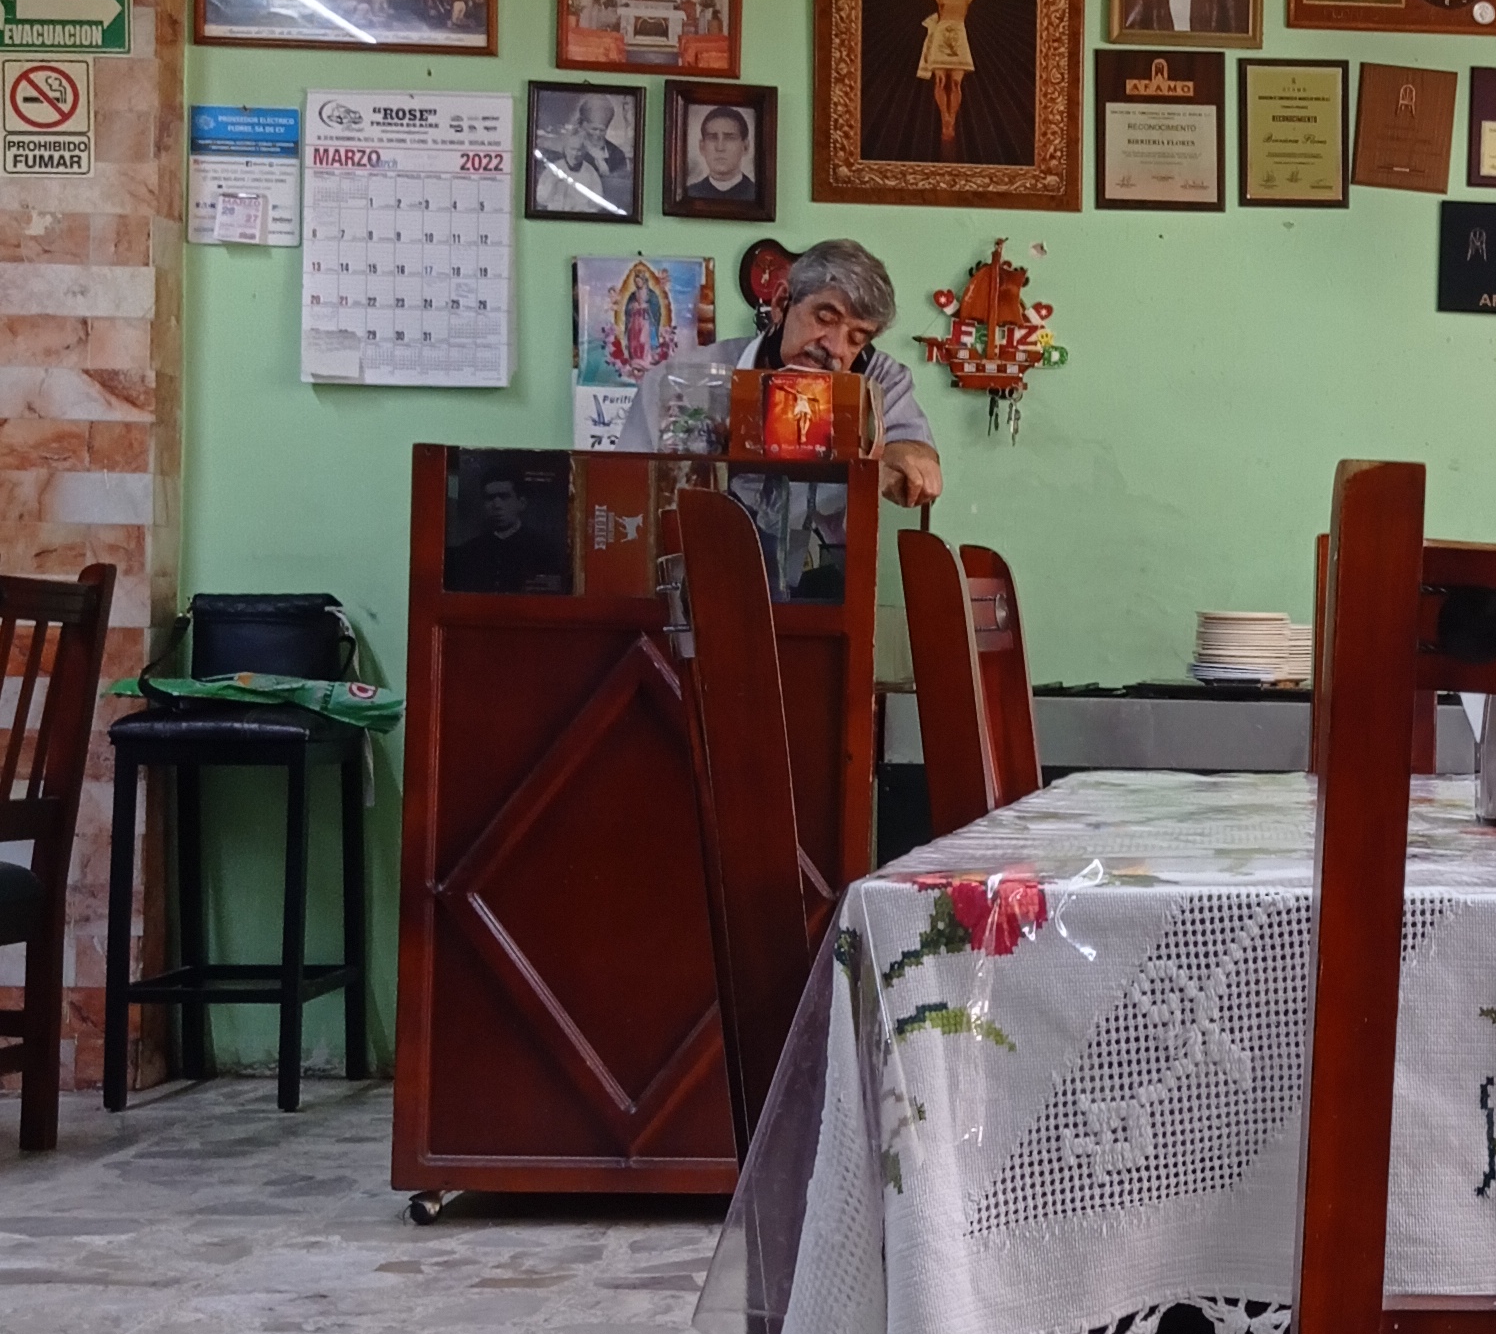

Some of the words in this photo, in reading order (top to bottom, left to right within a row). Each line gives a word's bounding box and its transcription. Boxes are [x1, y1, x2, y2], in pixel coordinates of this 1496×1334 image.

[4, 24, 103, 46] EVACUACION
[1130, 82, 1191, 94] AFAMO
[1127, 123, 1197, 132] RECONOCIMIENTO
[7, 140, 88, 152] PROHIBIDO
[13, 153, 82, 169] FUMAR
[313, 147, 381, 168] MARZO
[459, 153, 504, 172] 2022
[368, 197, 374, 208] 1
[424, 232, 434, 243] 10
[452, 234, 461, 244] 11
[480, 234, 489, 245] 12
[312, 262, 321, 272] 13
[340, 262, 349, 273] 14
[368, 264, 377, 274] 15
[396, 265, 406, 275] 16
[423, 332, 432, 342] 31
